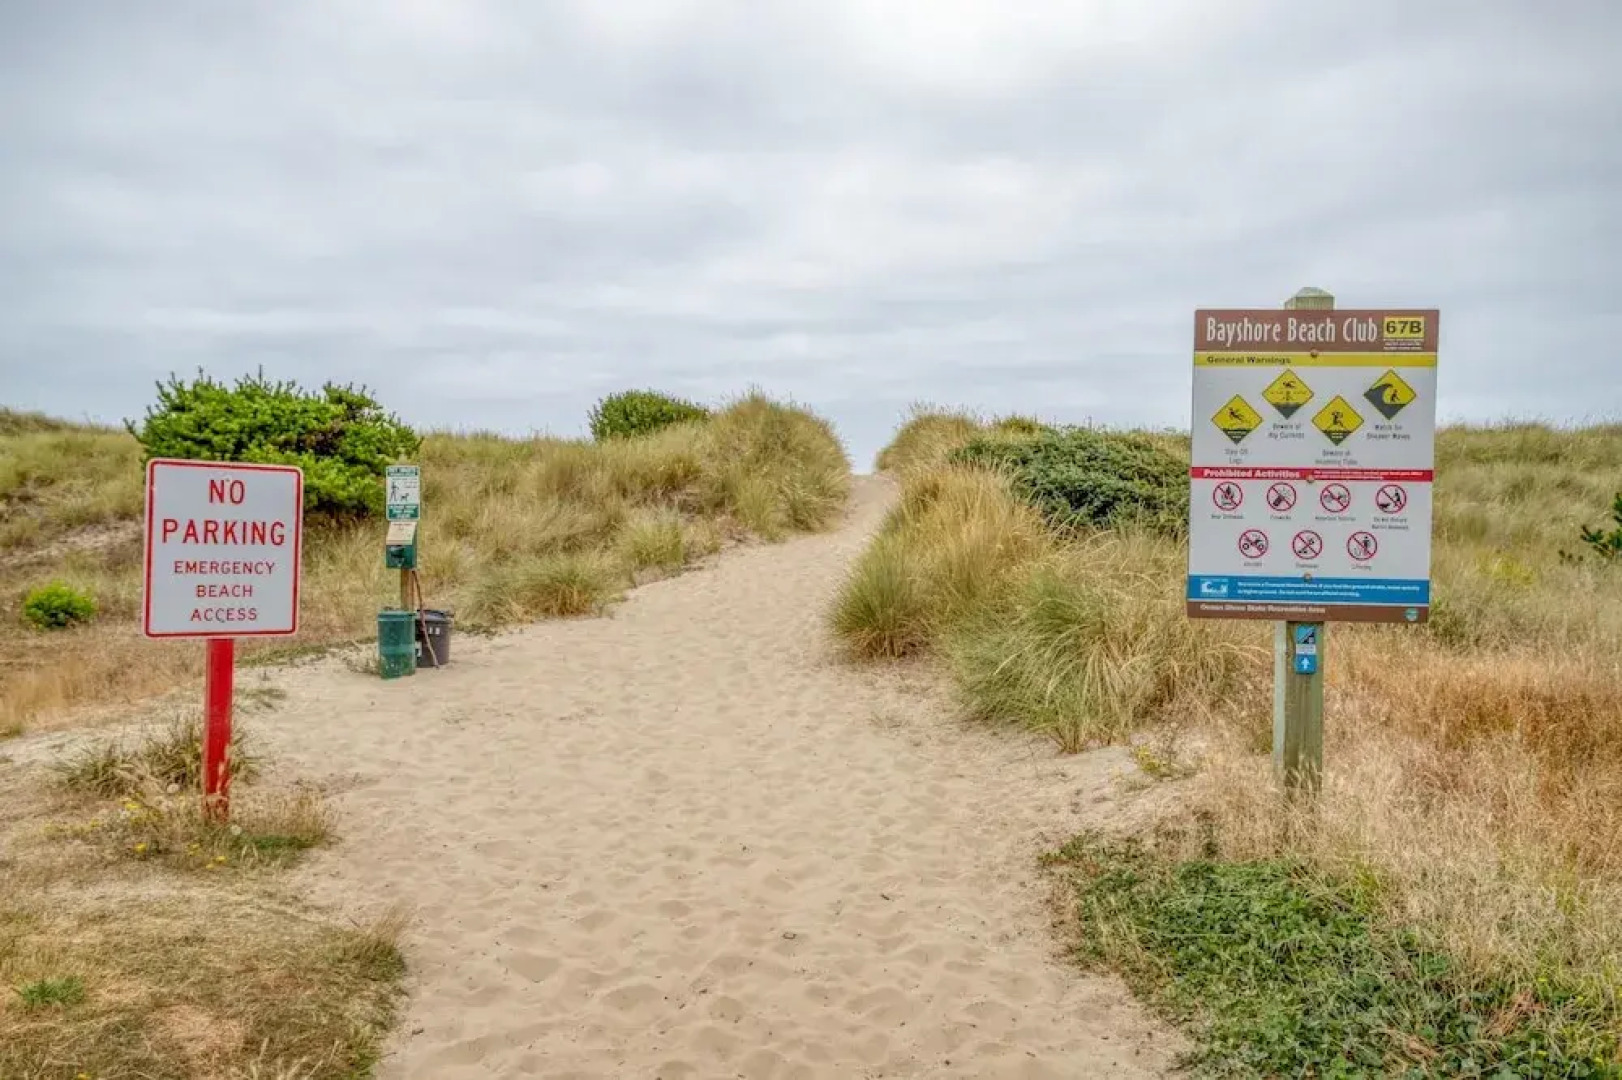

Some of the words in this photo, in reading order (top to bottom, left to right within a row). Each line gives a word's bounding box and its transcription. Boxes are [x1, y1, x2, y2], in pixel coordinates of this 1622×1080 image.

[1206, 317, 1281, 347] Bayshore
[1287, 317, 1336, 342] Beach
[1342, 317, 1378, 342] Club
[1385, 320, 1422, 334] 67B
[1206, 355, 1245, 364] General
[1246, 356, 1291, 365] Warnings
[1204, 469, 1252, 478] Prohibited
[1253, 469, 1300, 479] Activities
[209, 479, 244, 504] NO
[162, 519, 285, 546] PARKING
[174, 560, 275, 575] EMERGENCY
[196, 585, 253, 598] BEACH
[190, 608, 258, 621] ACCESS
